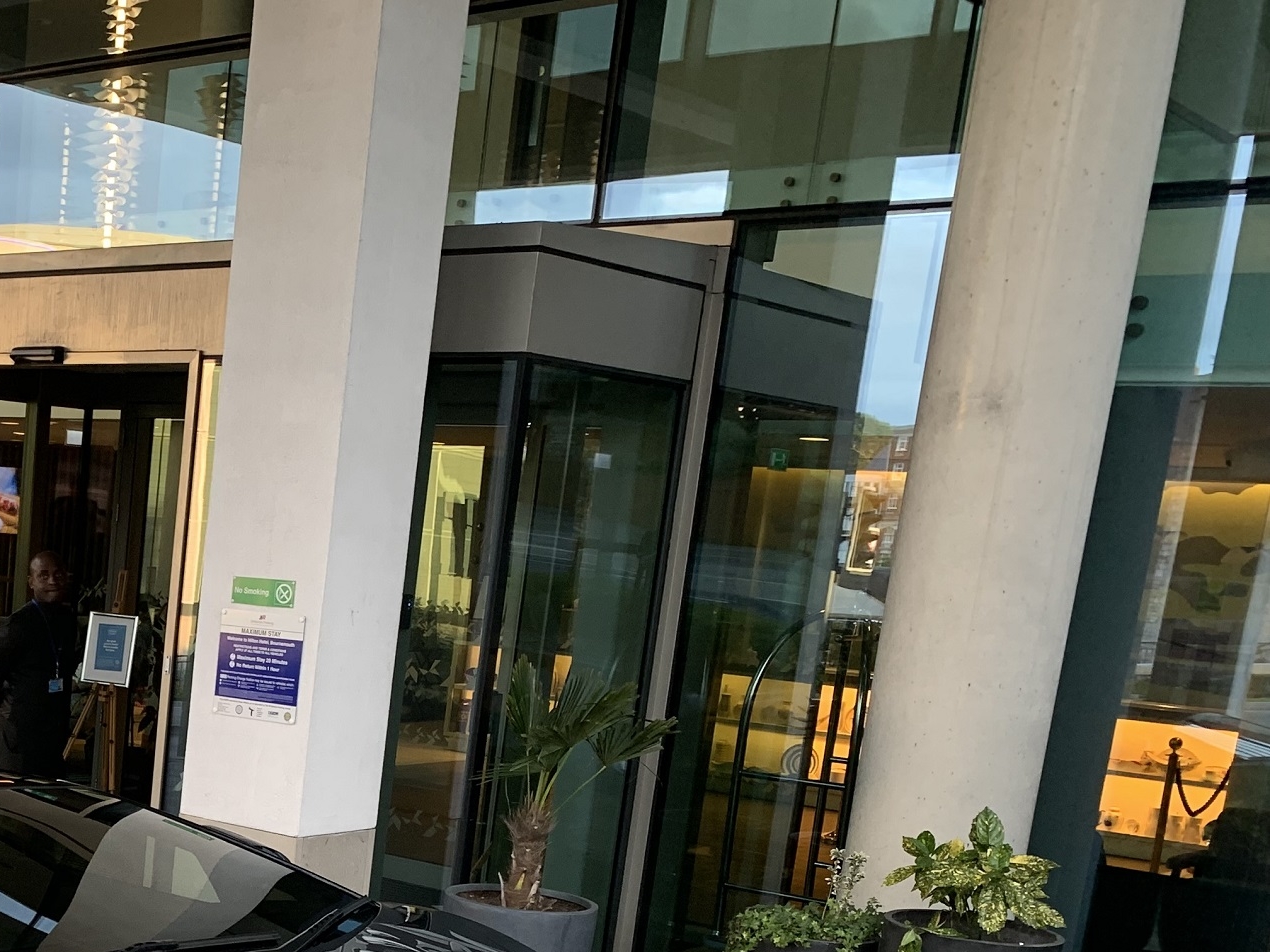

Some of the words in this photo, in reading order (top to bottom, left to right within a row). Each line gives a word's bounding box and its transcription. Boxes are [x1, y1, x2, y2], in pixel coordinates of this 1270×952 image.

[234, 586, 243, 594] No
[243, 587, 270, 598] Smoking
[241, 628, 267, 636] MAXIMUM
